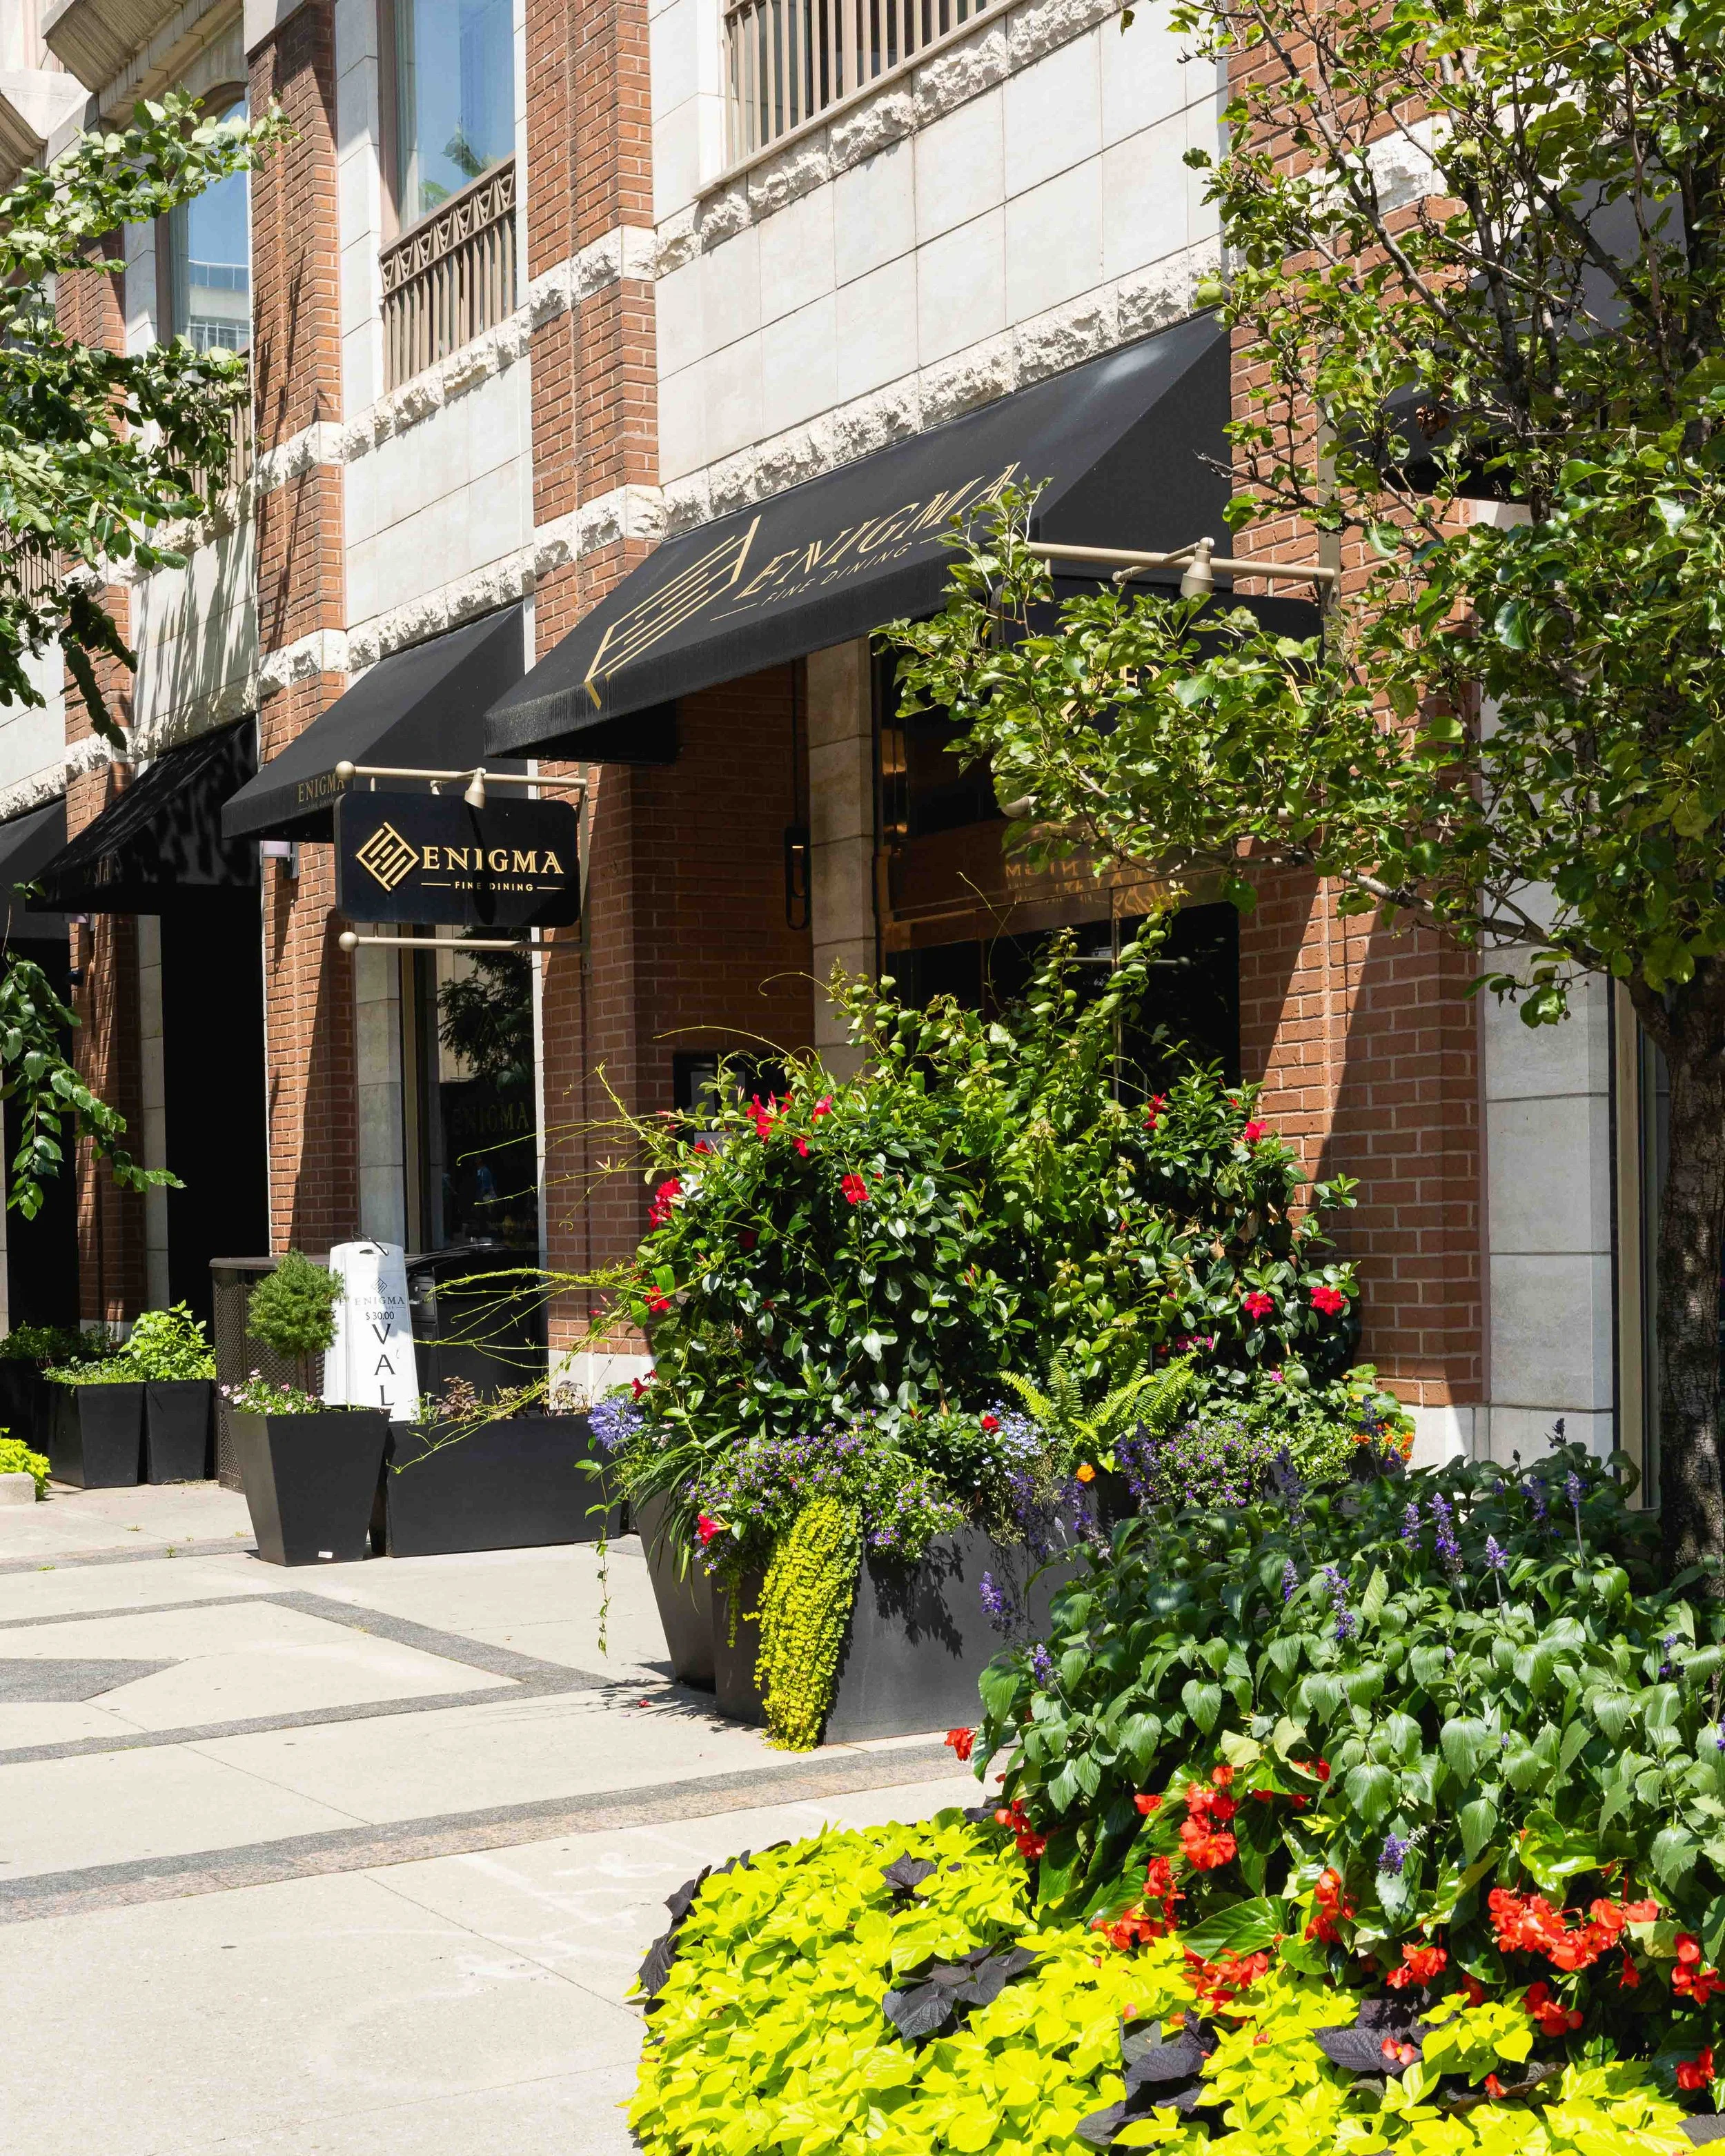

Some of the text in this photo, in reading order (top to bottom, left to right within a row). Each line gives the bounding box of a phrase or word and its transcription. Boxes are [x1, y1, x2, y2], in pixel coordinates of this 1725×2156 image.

[733, 461, 1021, 600] ENIGMA
[761, 542, 913, 606] FINE DINING
[422, 845, 564, 874] ENIGMA
[455, 881, 533, 891] FINE DINING
[355, 1296, 405, 1306] ENIGMA
[371, 1323, 396, 1418] VAL
